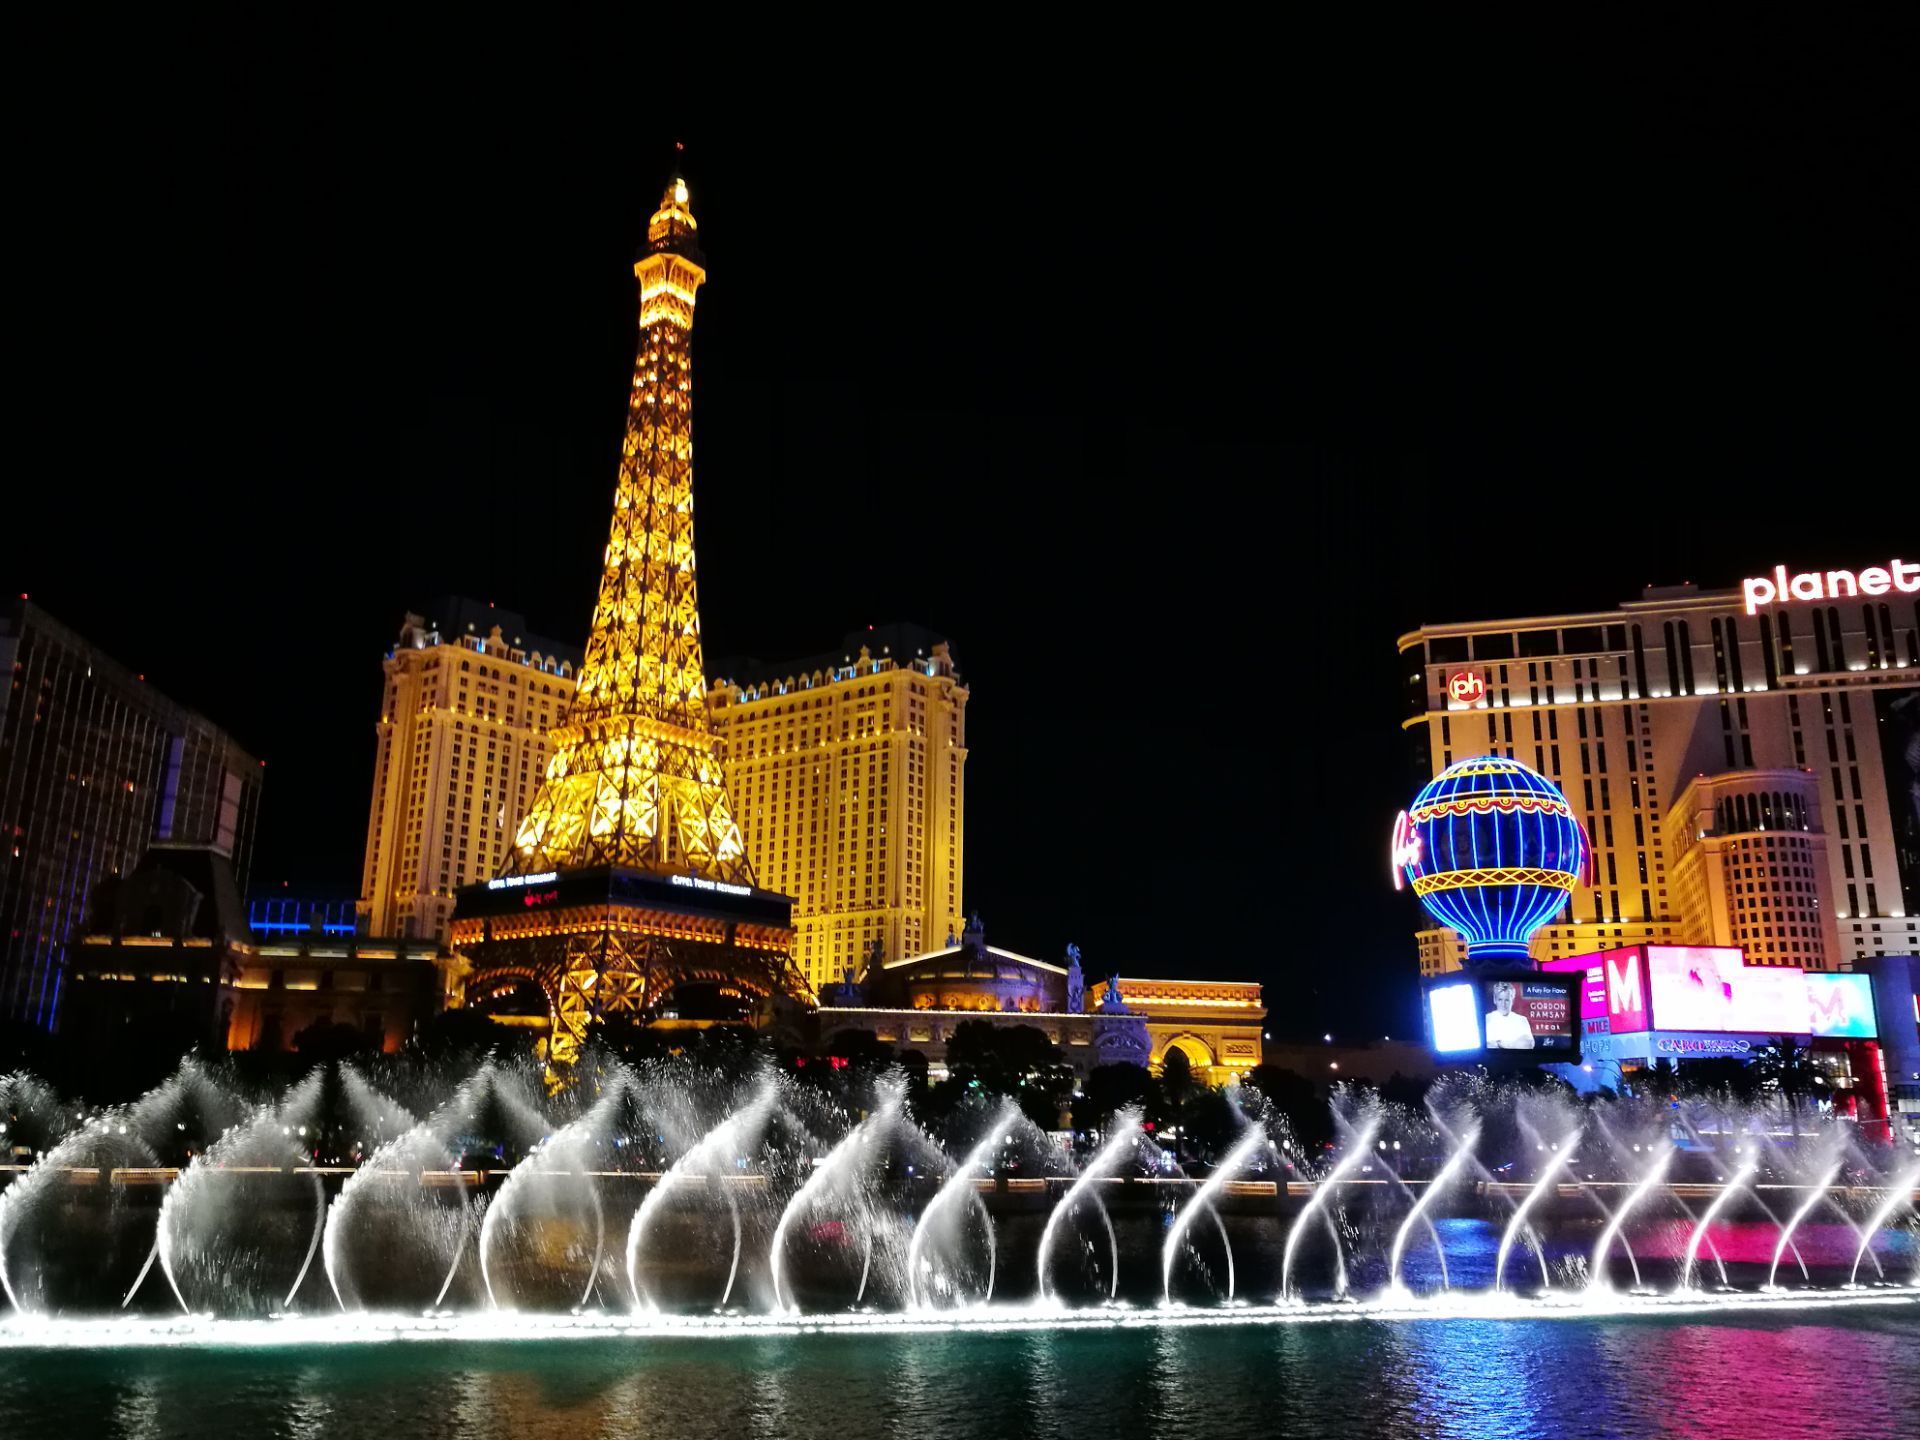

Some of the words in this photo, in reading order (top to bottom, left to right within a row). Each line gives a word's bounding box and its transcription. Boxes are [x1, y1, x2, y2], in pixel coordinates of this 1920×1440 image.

[1743, 559, 1920, 616] planet
[1453, 672, 1483, 699] ph
[1607, 956, 1642, 1014] M
[1530, 1002, 1566, 1010] GORDON
[1530, 1011, 1566, 1019] RAMSAY
[1587, 1021, 1608, 1034] MILE
